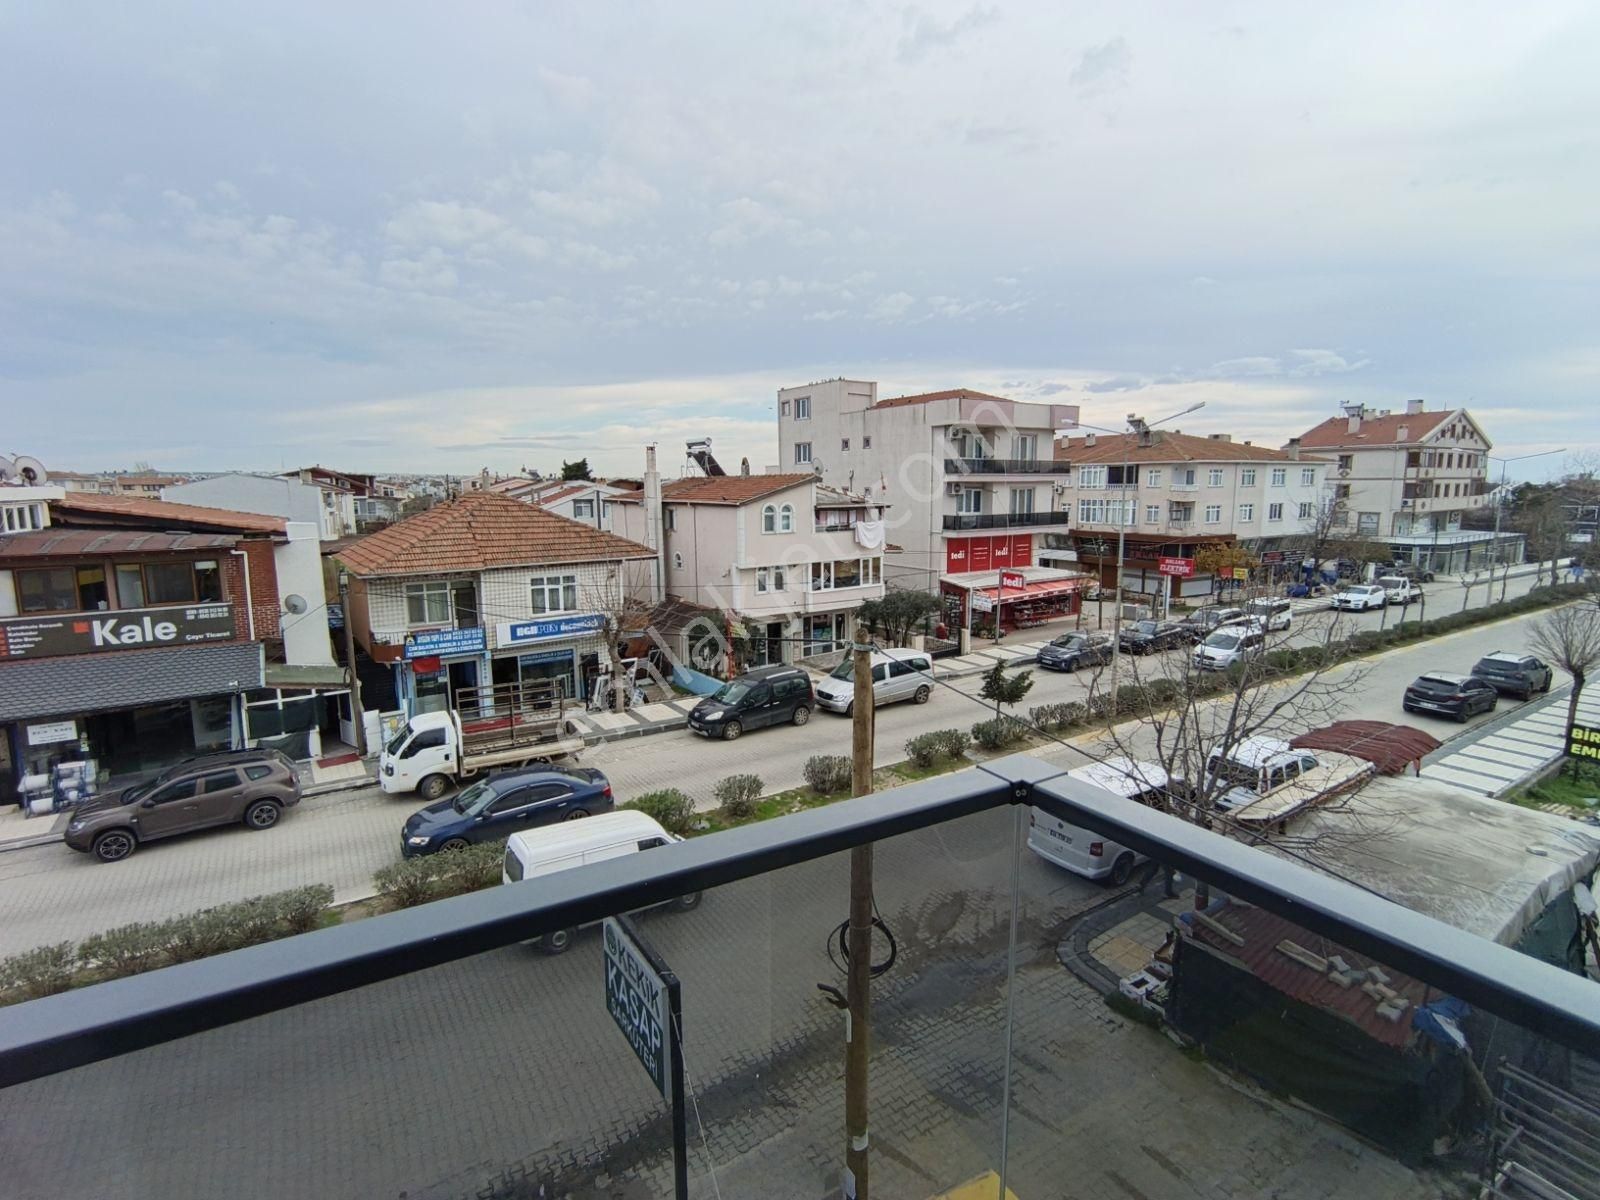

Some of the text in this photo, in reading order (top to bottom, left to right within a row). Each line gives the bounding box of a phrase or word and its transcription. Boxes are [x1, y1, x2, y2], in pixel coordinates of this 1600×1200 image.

[1002, 577, 1023, 588] tedi
[92, 616, 178, 646] Kale
[1571, 728, 1600, 743] BİR
[607, 957, 661, 1055] KASAP
